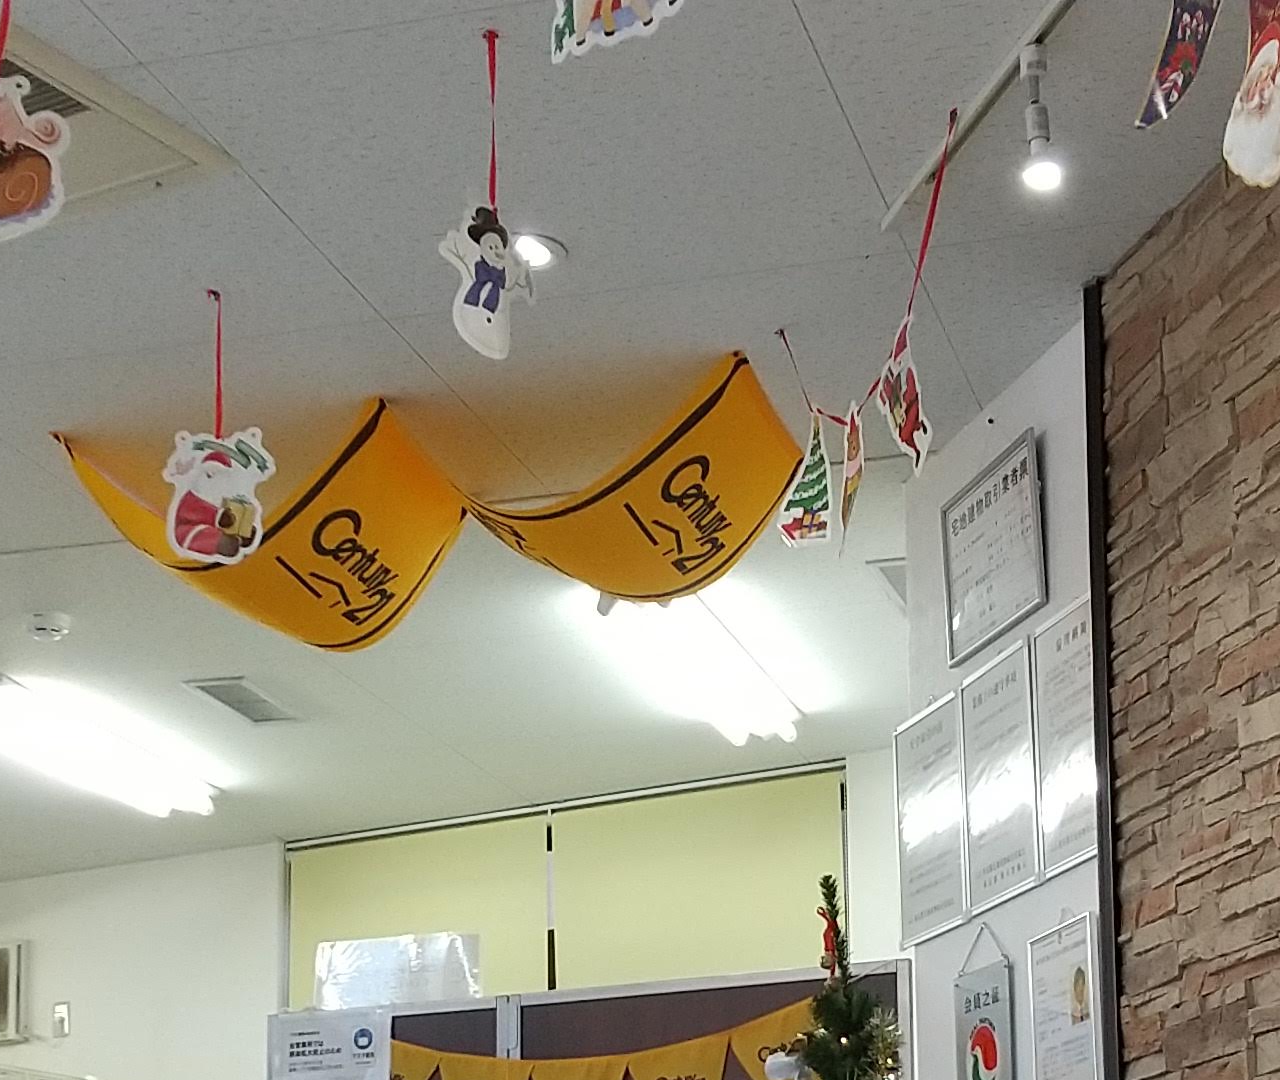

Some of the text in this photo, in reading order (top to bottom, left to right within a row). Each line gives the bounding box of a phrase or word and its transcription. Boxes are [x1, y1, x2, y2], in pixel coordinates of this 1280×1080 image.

[312, 508, 399, 626] Century 21
[660, 455, 733, 576] Century 21
